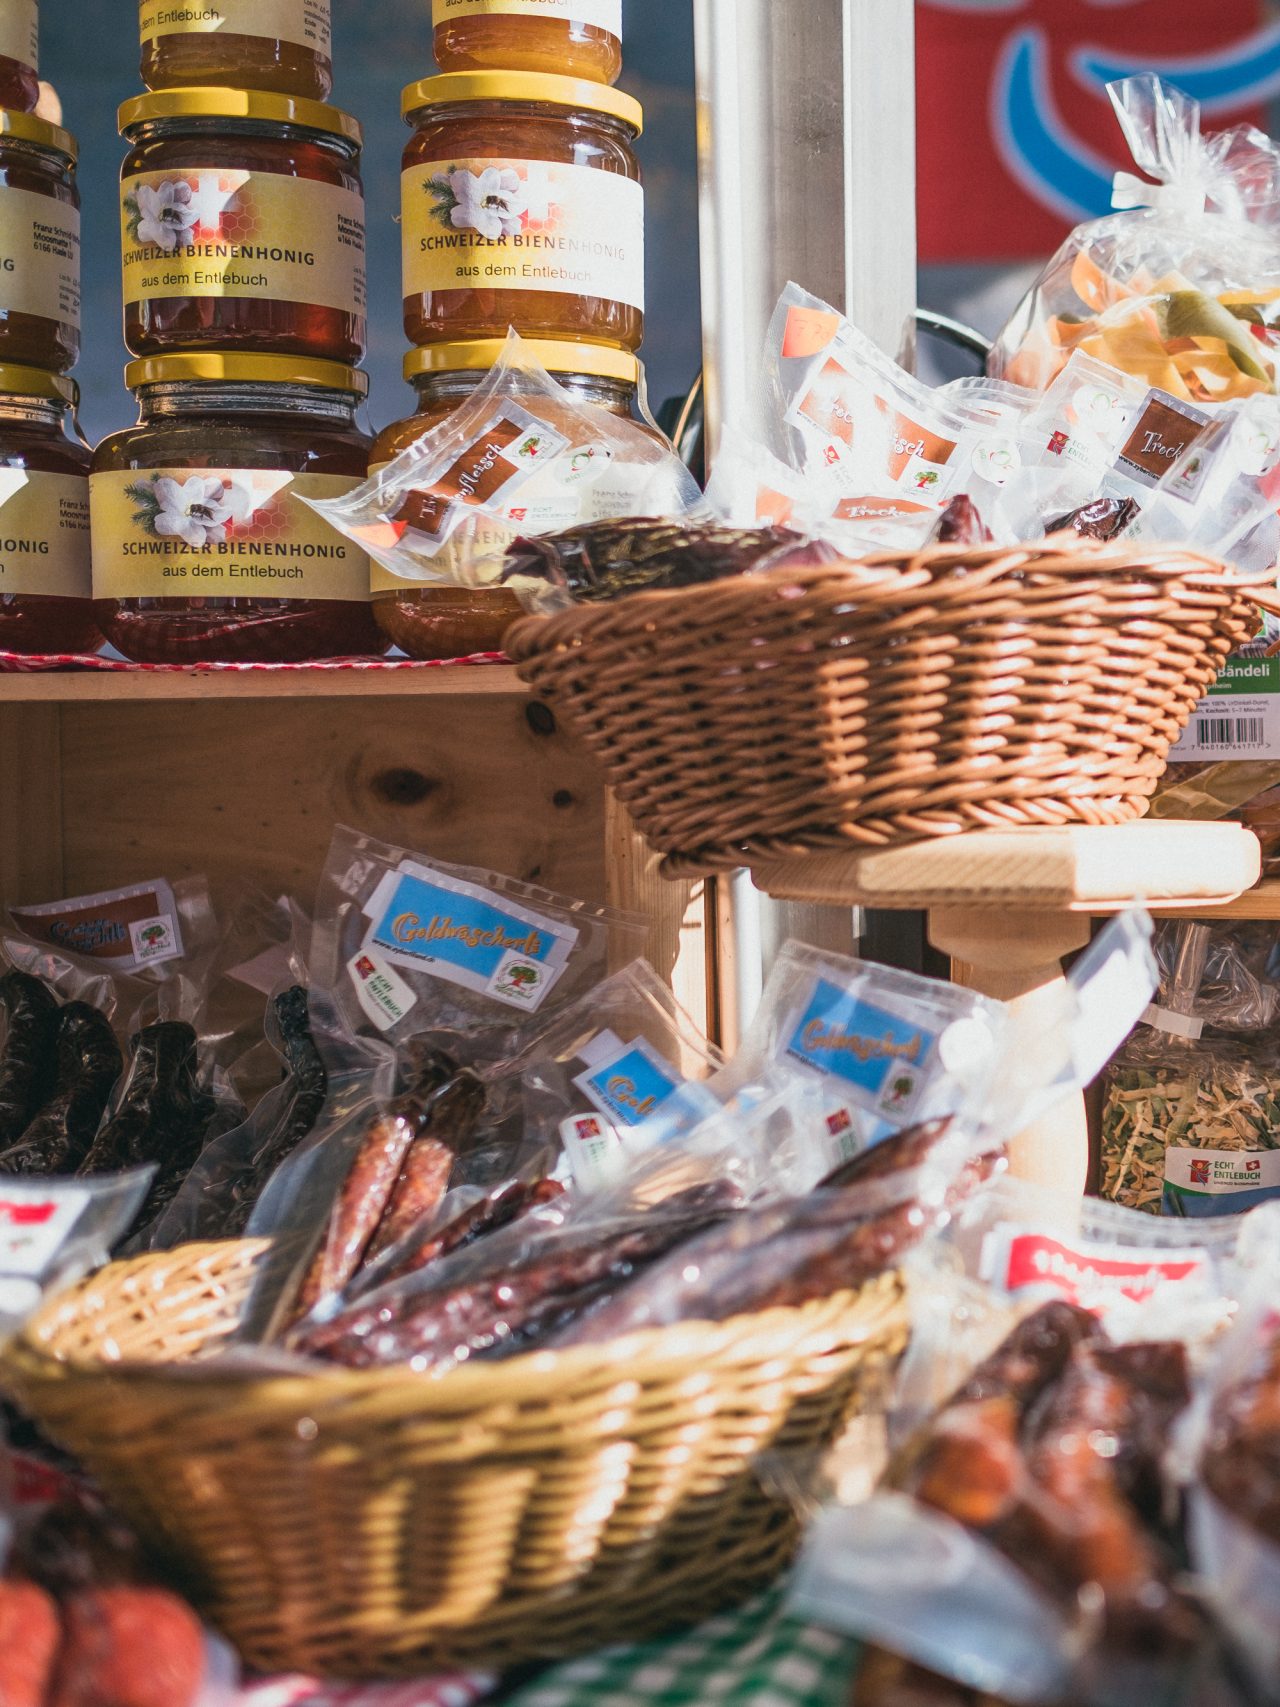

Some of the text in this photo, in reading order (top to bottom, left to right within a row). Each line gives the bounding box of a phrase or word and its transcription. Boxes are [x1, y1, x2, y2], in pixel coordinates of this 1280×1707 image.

[157, 9, 220, 25] Entlebuch
[421, 234, 625, 260] SCHWEIZER BIENENHONIG
[123, 244, 315, 267] SCHWEIZER BIENENHONIG
[141, 271, 268, 287] aus dem Entlebuch
[455, 263, 592, 281] aus dem Entlebuch
[1141, 430, 1185, 462] Trock
[0, 539, 49, 554] ONIG
[122, 542, 346, 559] SCHWEIZER BIENENHONIG
[162, 564, 304, 579] aus dem Entlebuch
[1217, 664, 1270, 678] Bändeli
[1214, 1160, 1235, 1169] ECHT
[1213, 1171, 1261, 1179] ENTLEBUCH
